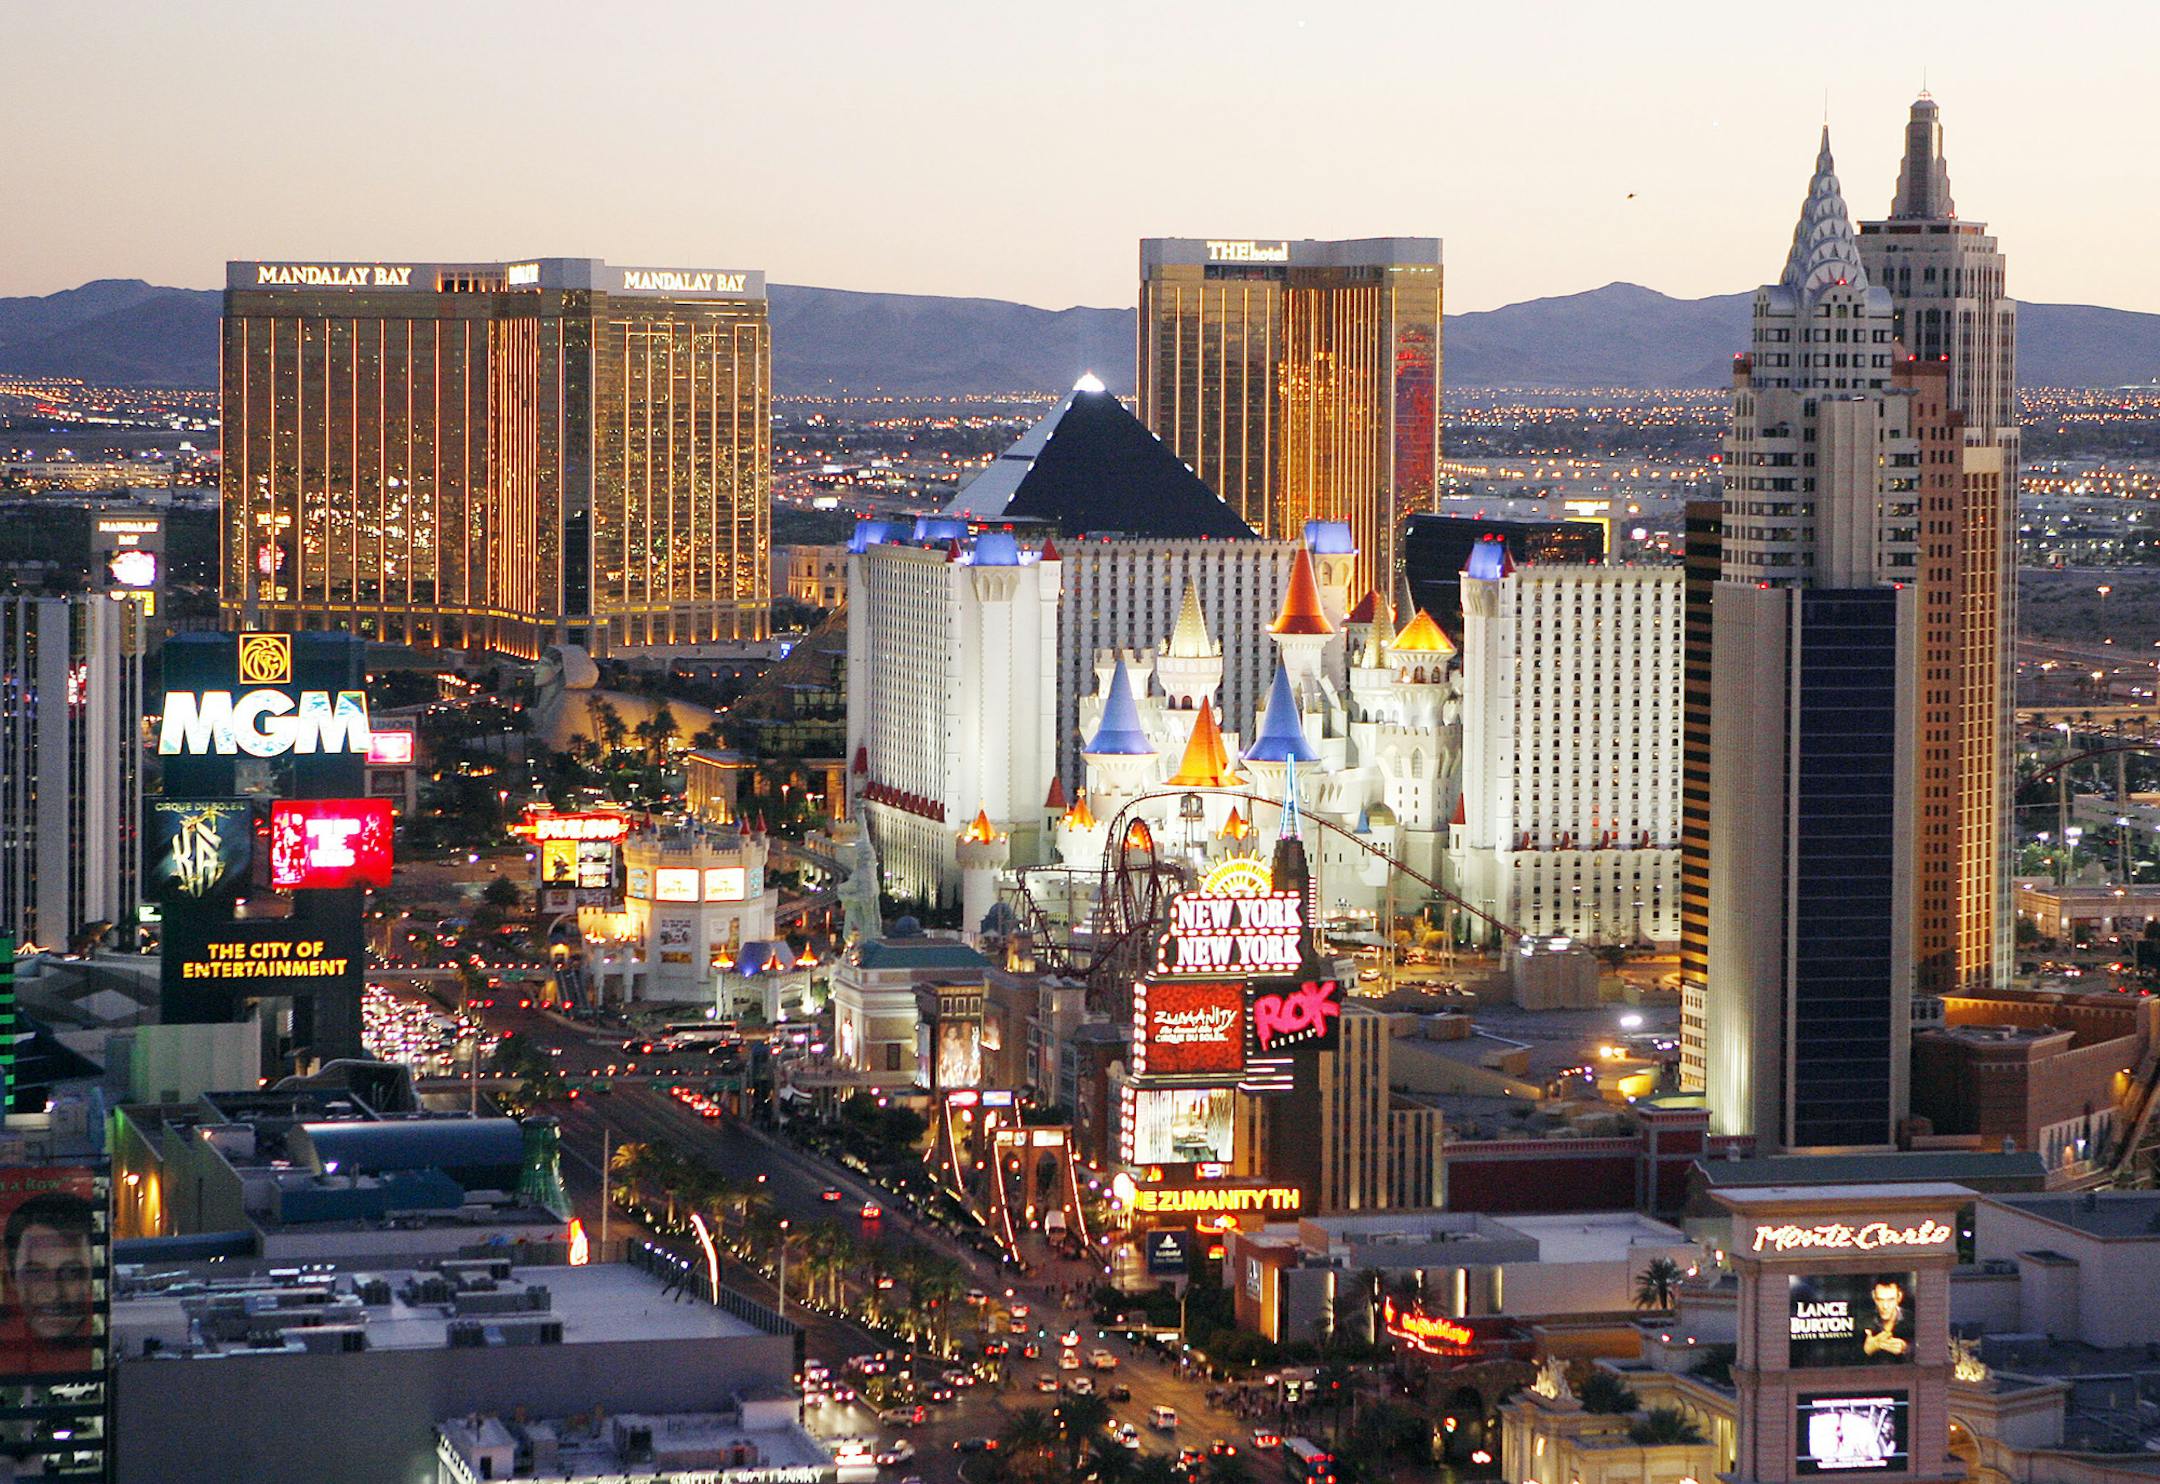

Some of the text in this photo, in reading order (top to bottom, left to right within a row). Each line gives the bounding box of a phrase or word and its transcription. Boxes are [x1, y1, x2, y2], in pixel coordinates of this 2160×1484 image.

[257, 266, 412, 286] MANDALAY BAY
[623, 271, 746, 293] MANDALAY BAY
[158, 688, 370, 757] MGM
[155, 802, 245, 813] CIRQUE DU SOLEIL
[1177, 898, 1302, 929] NEW YORK
[207, 940, 324, 960] THE CITY OF
[1177, 934, 1302, 966] NEW YORK
[183, 959, 348, 979] ENTERTAINMENT
[1154, 1005, 1238, 1032] ZUMANITY
[1158, 1189, 1267, 1211] ZUMANITY
[1752, 1219, 1951, 1251] Monte Carlo
[1797, 1301, 1848, 1317] LANCE
[1790, 1316, 1855, 1333] BURTON
[670, 1473, 716, 1484] SMITH
